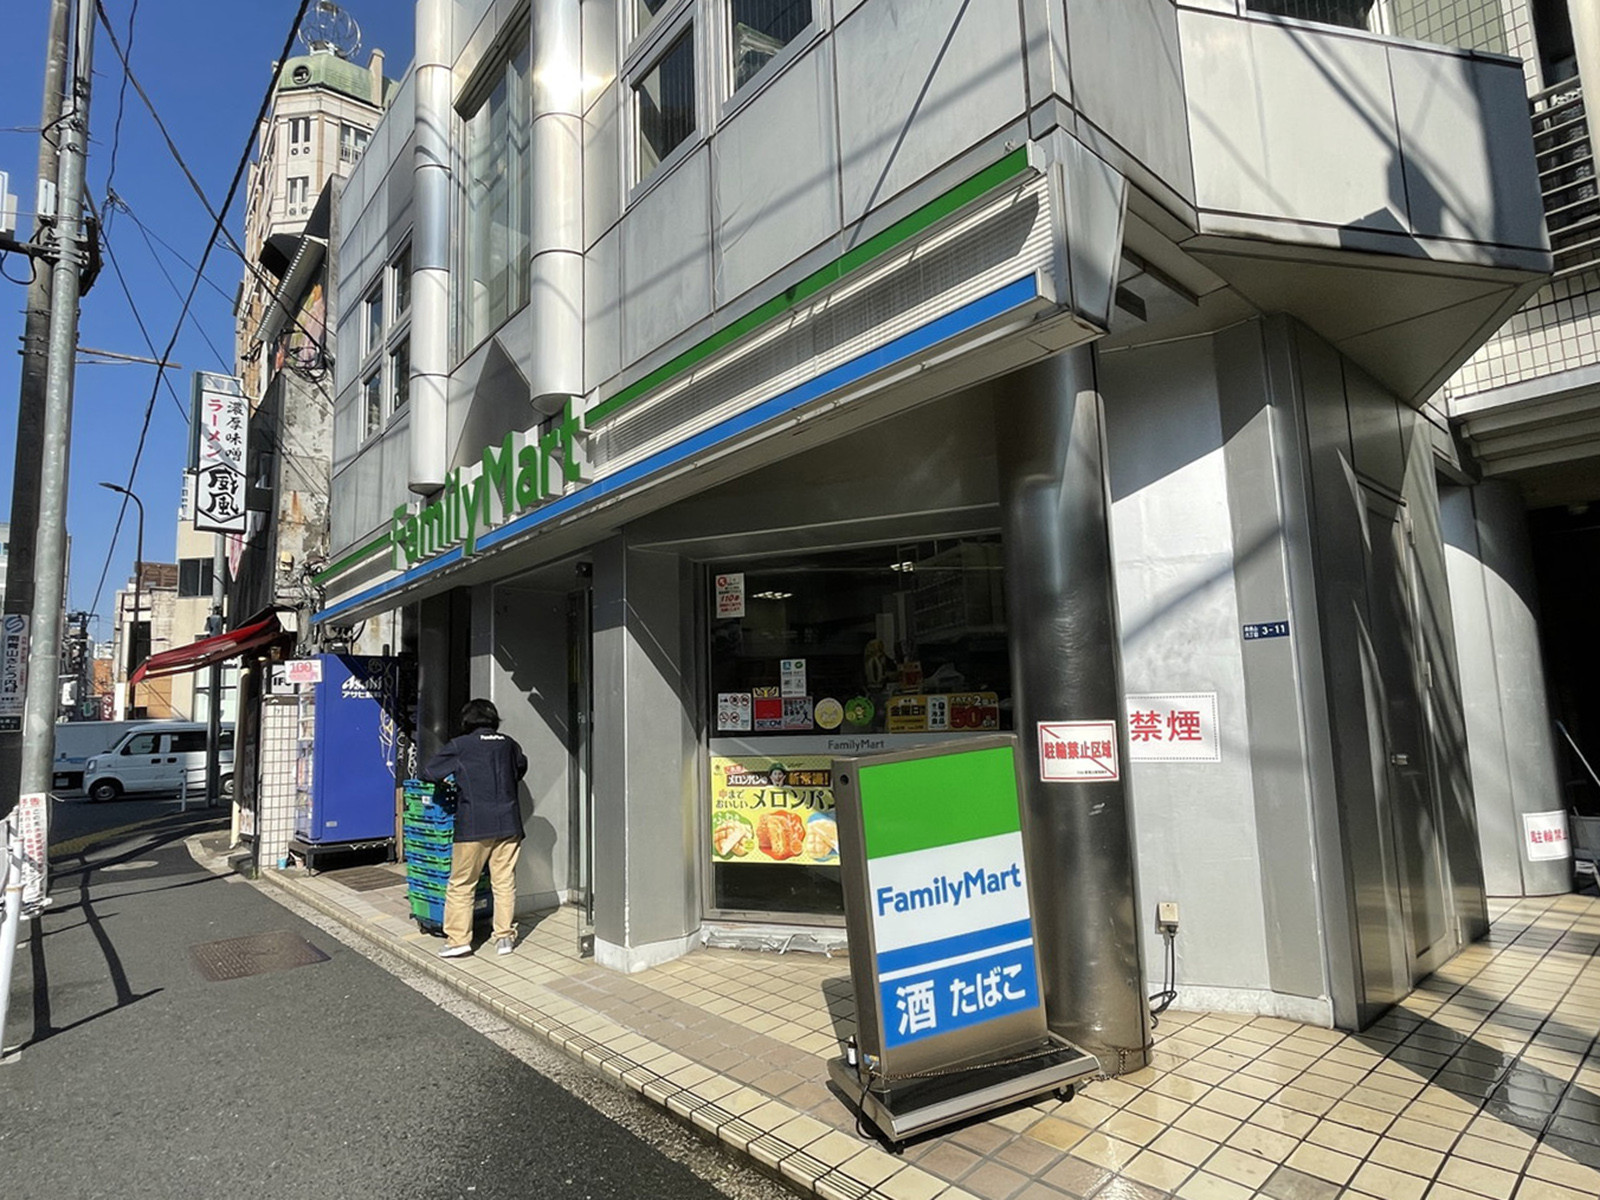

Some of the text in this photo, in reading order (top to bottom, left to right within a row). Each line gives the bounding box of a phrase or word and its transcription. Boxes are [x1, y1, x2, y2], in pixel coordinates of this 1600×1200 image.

[206, 399, 223, 458] ラーメン
[225, 400, 244, 462] 濃厚味噌
[390, 394, 588, 571] FamilyMart
[1262, 624, 1286, 635] 3-11
[342, 675, 382, 691] Asahi
[827, 739, 885, 752] FamilyMart
[1129, 710, 1202, 743] 禁煙
[876, 863, 1022, 917] FamilyMart
[896, 963, 1026, 1036] 酒 たばこ
